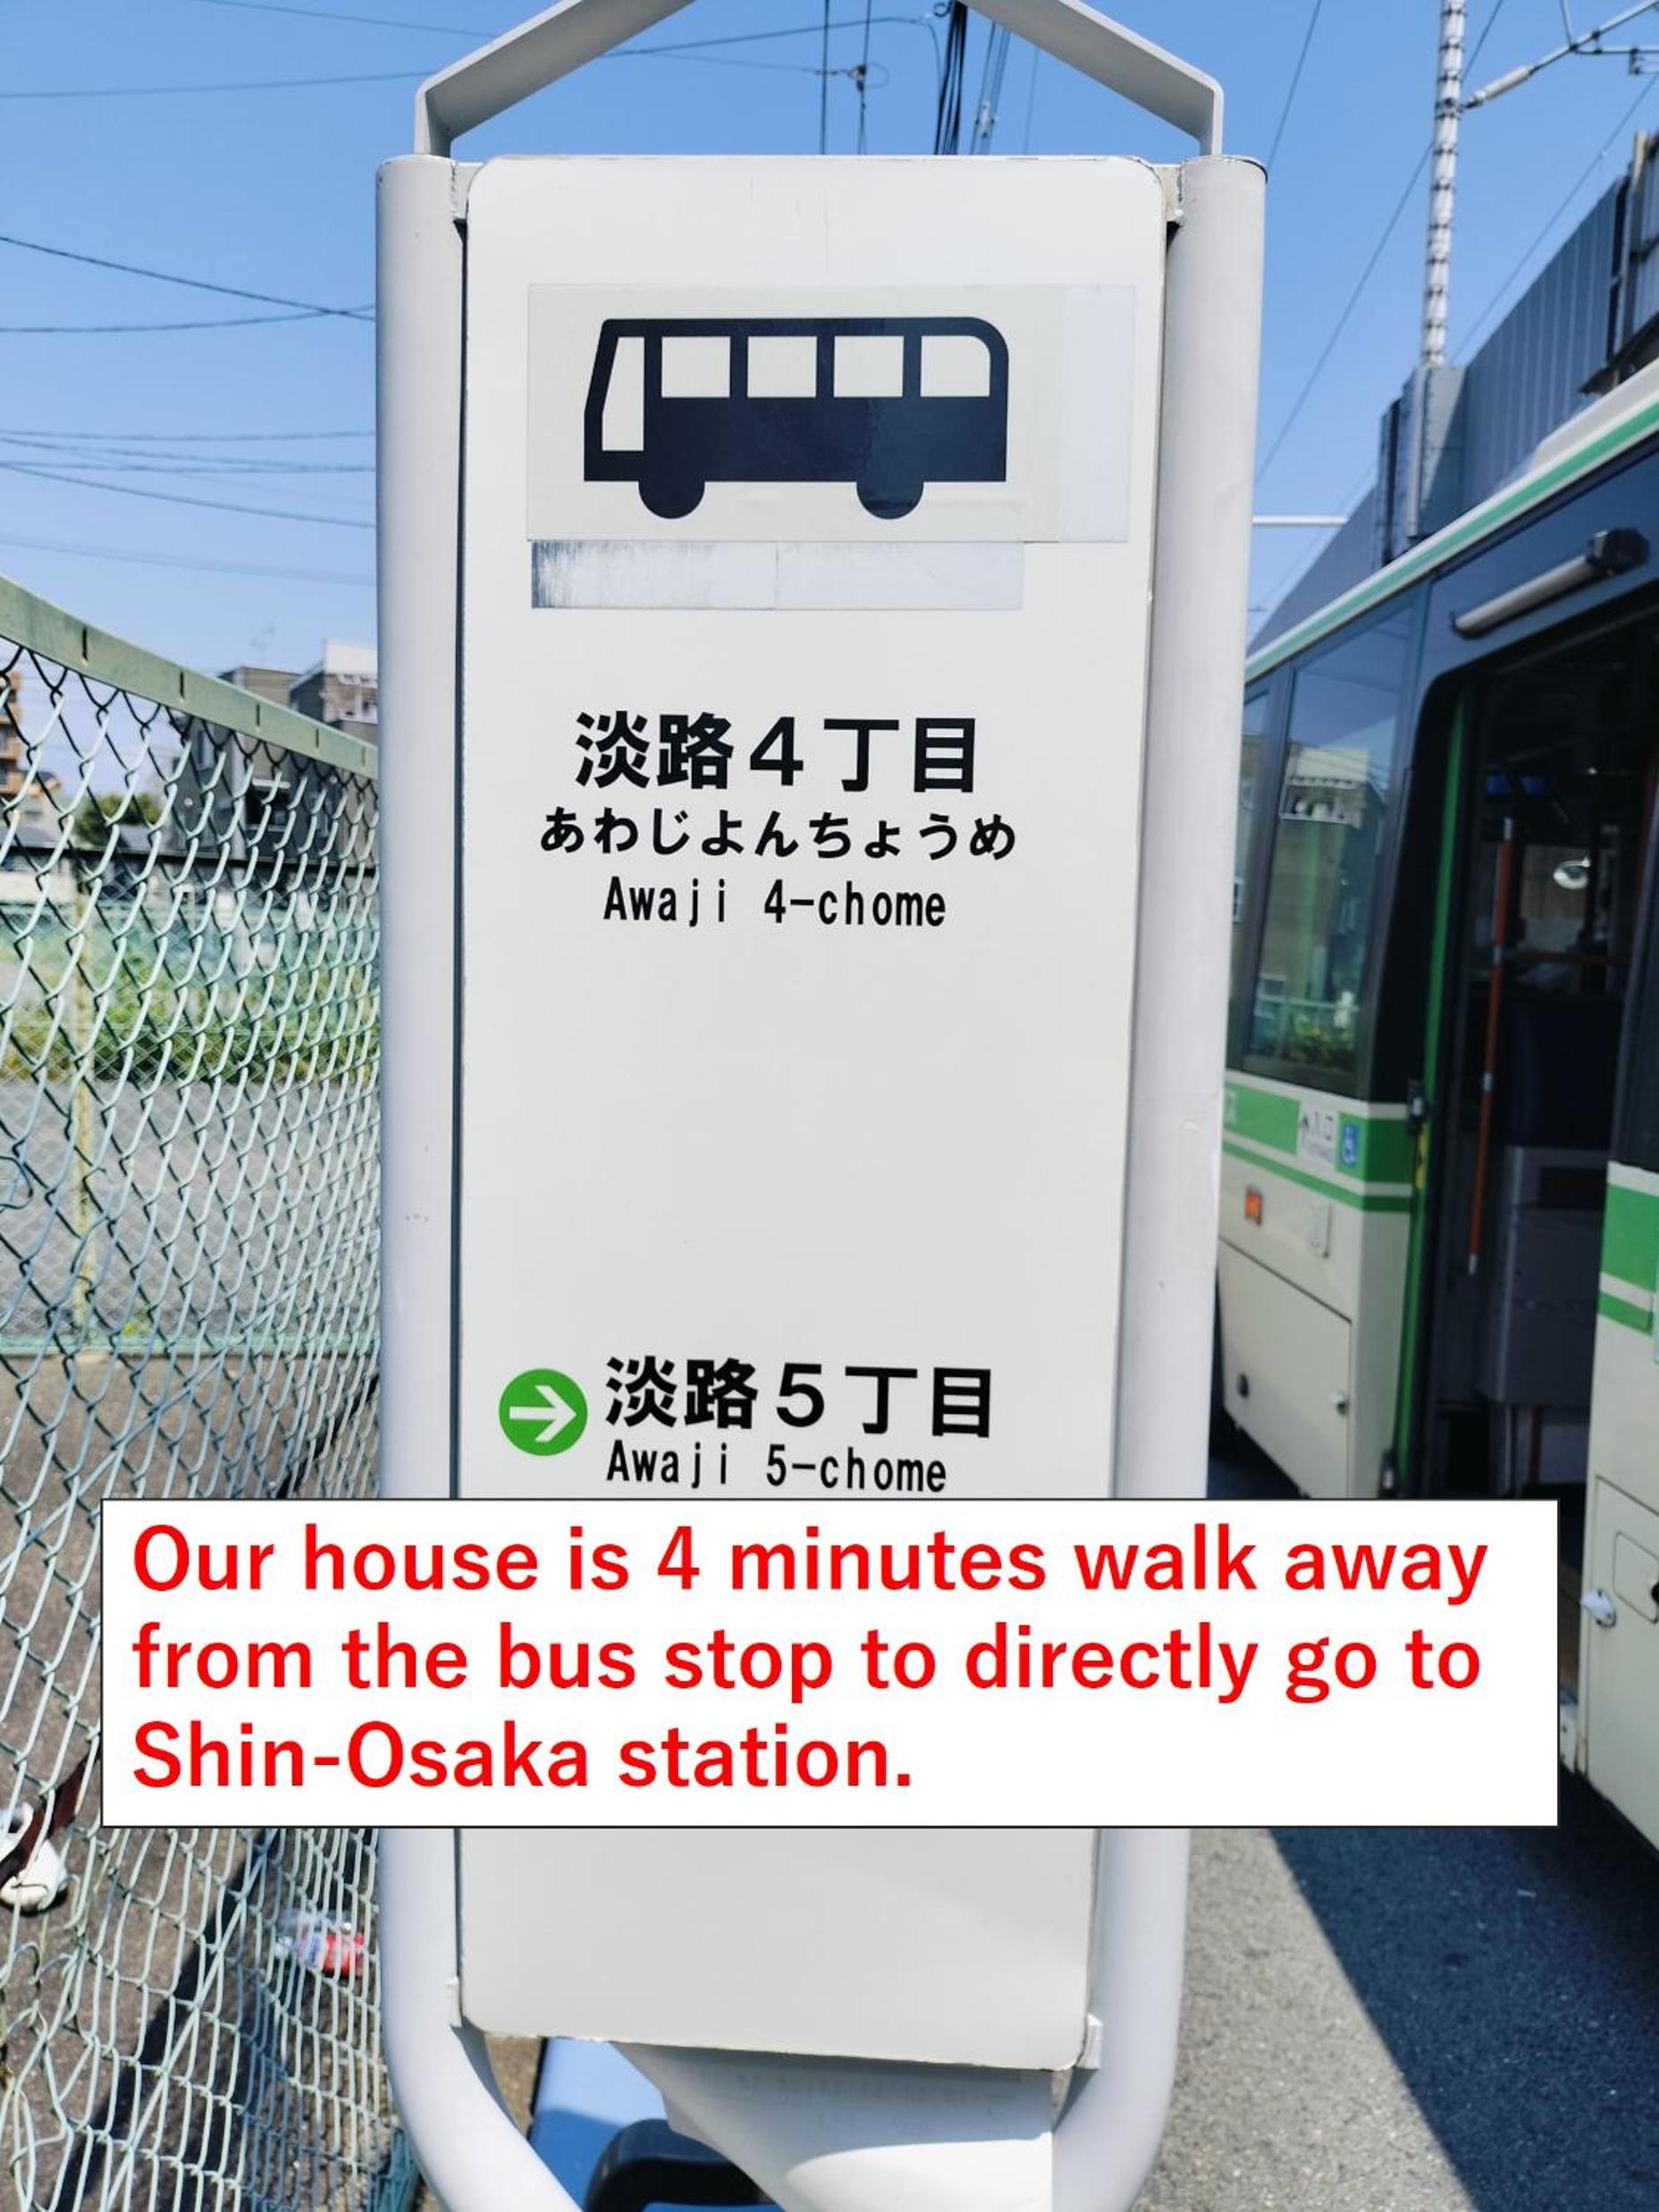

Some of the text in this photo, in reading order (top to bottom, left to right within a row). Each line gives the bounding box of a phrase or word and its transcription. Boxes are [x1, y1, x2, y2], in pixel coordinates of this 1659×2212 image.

[575, 710, 976, 794] 淡路4丁目
[540, 806, 1015, 861] あわじよんちょうめ
[602, 876, 946, 928] Awaji 4-chome
[605, 1355, 991, 1439] 淡路5丁目
[606, 1439, 947, 1493] Awaji 5-chome
